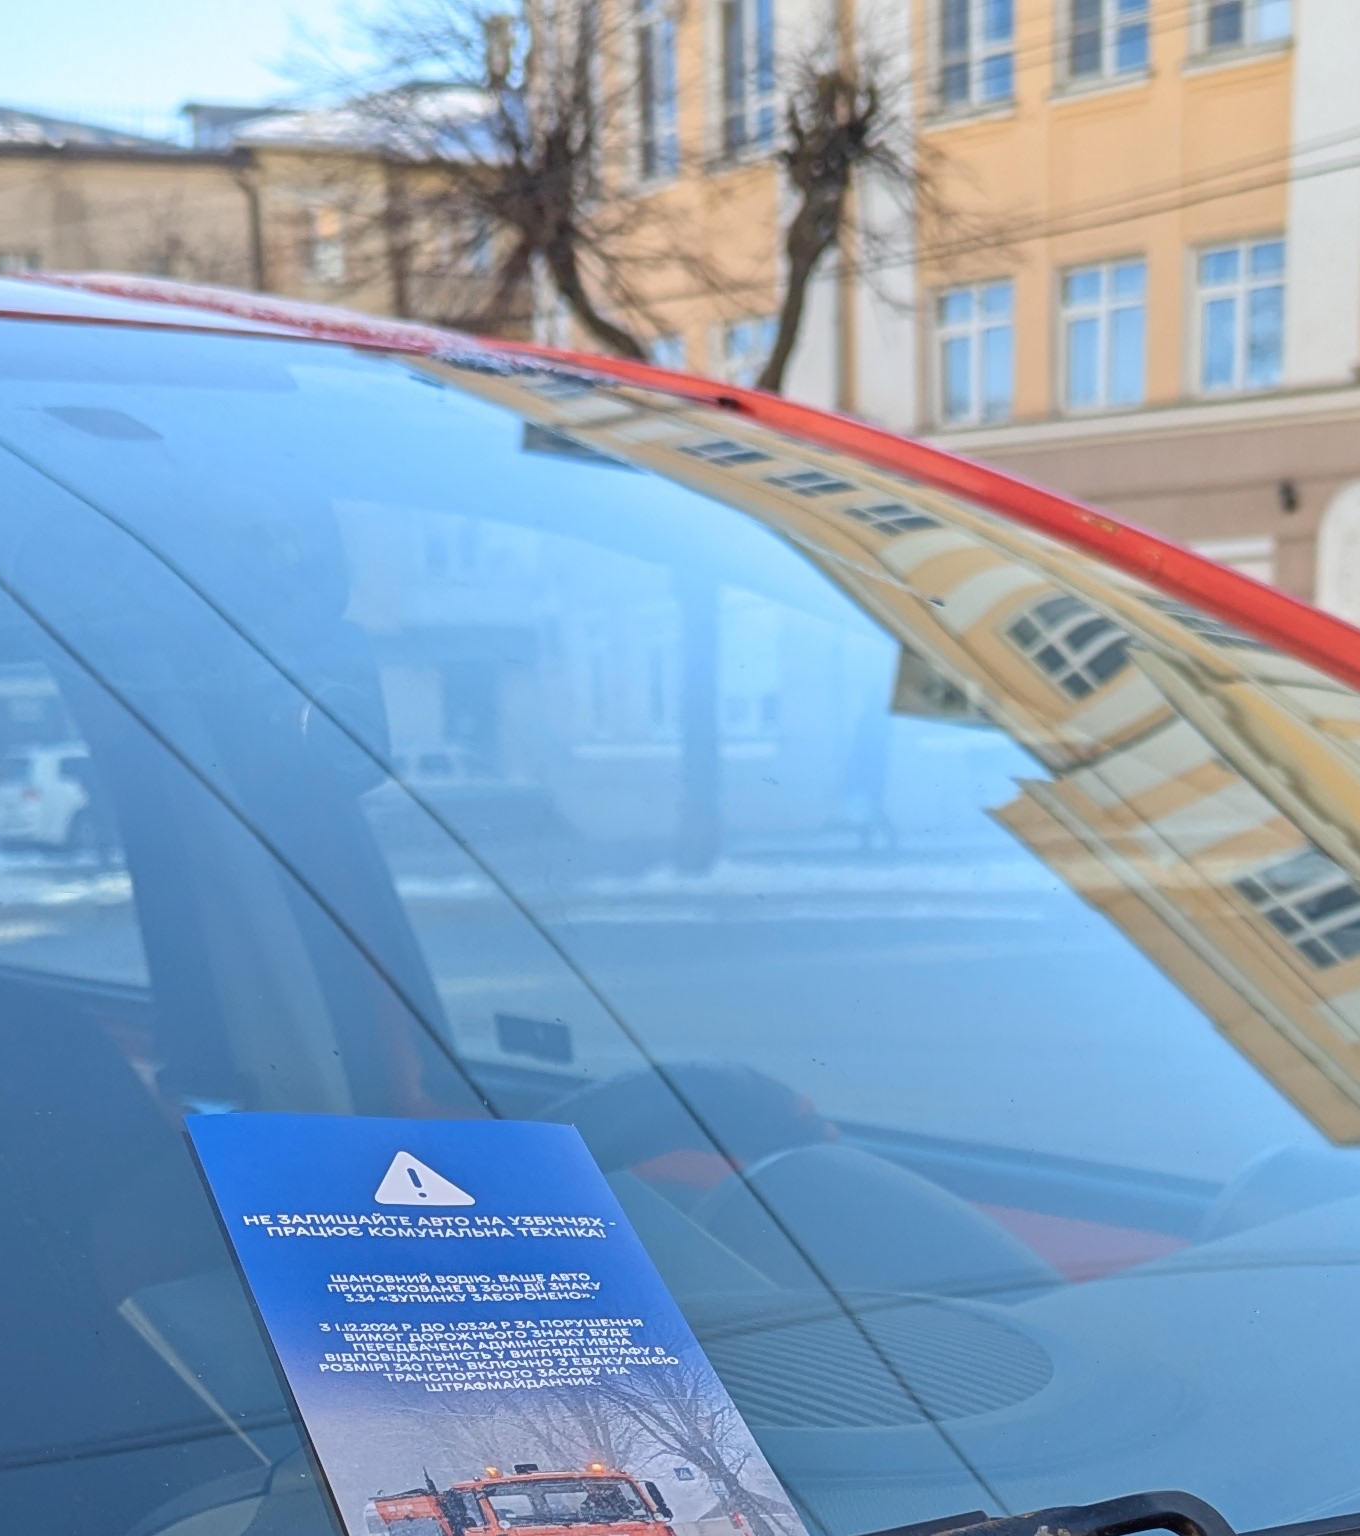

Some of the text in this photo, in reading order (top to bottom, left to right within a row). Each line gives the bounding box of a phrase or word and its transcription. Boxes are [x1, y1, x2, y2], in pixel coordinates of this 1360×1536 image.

[243, 1215, 273, 1226] НЕ
[277, 1213, 413, 1226] ЗАЛИШАЙТЕ
[418, 1216, 469, 1227] АВТО
[474, 1216, 506, 1226] НА
[507, 1216, 606, 1227] УЗБІЧЧЯХ
[267, 1226, 607, 1238] ПРАЦЮЄ КОМУНАЛЬНА ТЕХНІКА!
[330, 1273, 591, 1284] ШАНОВНИЙ ВОДІЮ, ВАШЕ АВТО
[327, 1280, 601, 1293] ПРИПАРКОВАНЕ В ЗОНІ ДІЇ ЗНАКУ
[344, 1291, 596, 1303] 3.34 «ЗУПИНКУ ЗАБОРОНЕНО».
[335, 1322, 398, 1332] 1.12.2024
[420, 1322, 445, 1332] ДО
[500, 1321, 510, 1330] Р
[514, 1320, 537, 1329] ЗА
[540, 1318, 644, 1329] ПОРУШЕННЯ
[343, 1328, 632, 1343] ВИМОГ ДОРОЖНЬОГО ЗНАКУ БУДЕ
[352, 1338, 633, 1353] ПЕРЕДБАЧЕНА АДМІНІСТРАТИВНА
[324, 1347, 666, 1363] ВІДПОВІДАЛЬНІСТЬ У ВИГЛЯДІ ШТРАФУ В
[319, 1363, 390, 1372] РОЗМІРІ
[392, 1363, 423, 1372] 340
[426, 1362, 464, 1372] ГРН,
[466, 1358, 554, 1370] ВКЛЮЧНО
[572, 1356, 679, 1366] ЕВАКУАЦІЄЮ
[383, 1366, 631, 1382] ТРАНСПОРТНОГО ЗАСОБУ НА
[424, 1377, 602, 1392] ШТРАФМАЙДАНЧИК.
